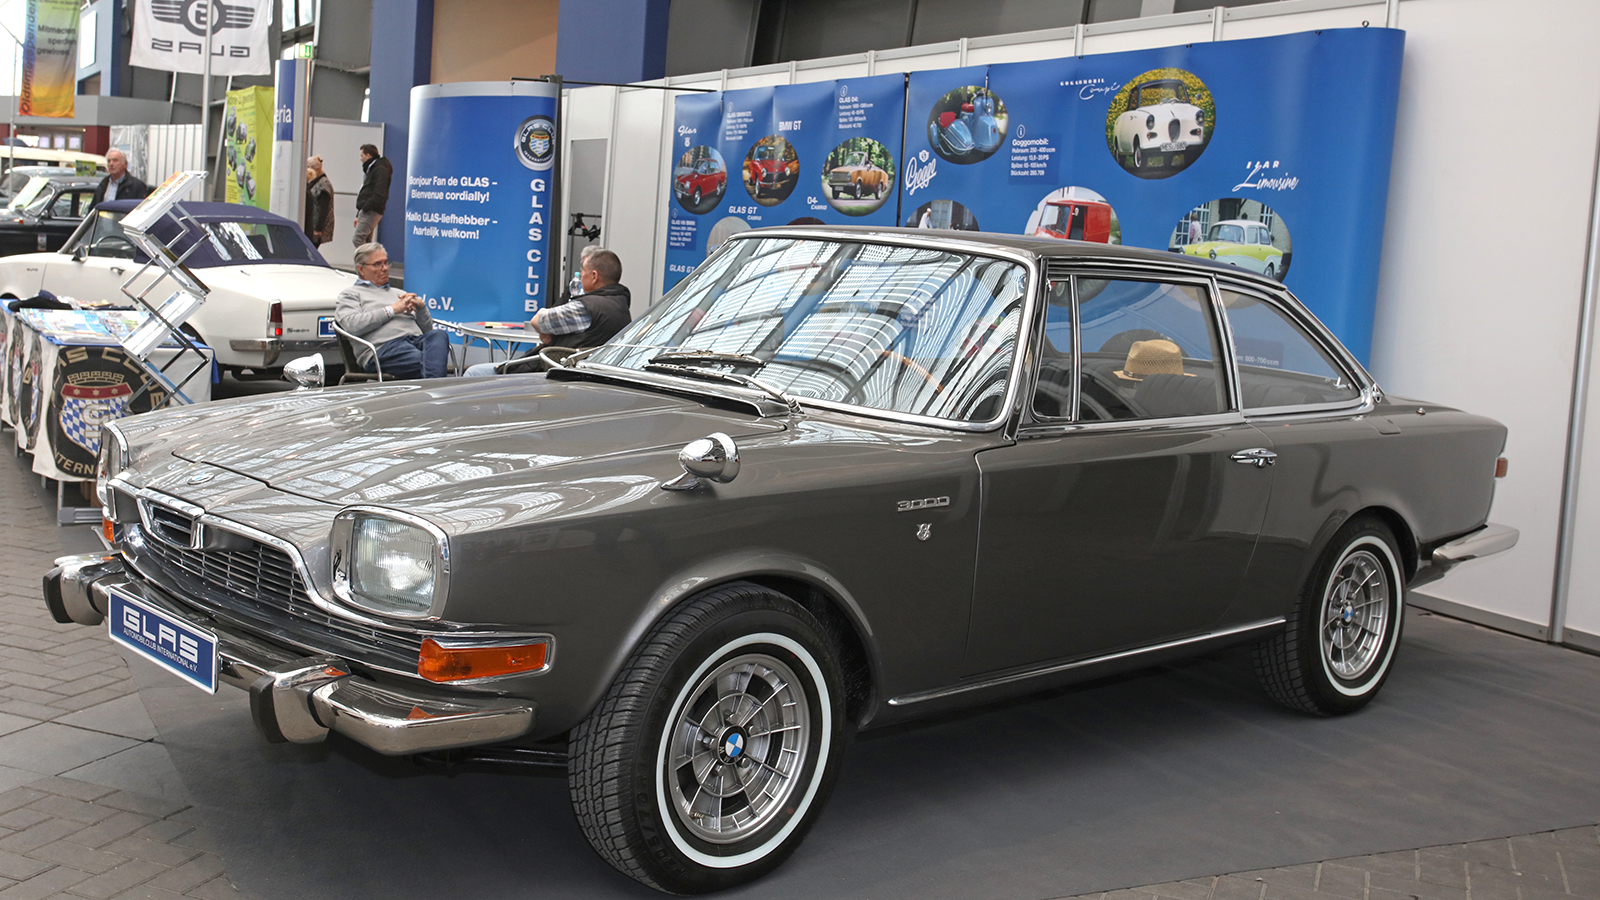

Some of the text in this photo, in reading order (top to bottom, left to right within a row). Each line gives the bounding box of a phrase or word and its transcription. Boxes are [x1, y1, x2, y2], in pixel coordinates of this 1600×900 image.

[521, 123, 540, 143] GLAS
[779, 120, 801, 131] BMW GT
[1012, 138, 1049, 147] Goggomobil:
[409, 176, 432, 187] Bonjour
[433, 176, 446, 186] Fan
[447, 176, 458, 186] de
[460, 176, 490, 187] GLAS
[1231, 164, 1300, 192] Limousine
[411, 189, 490, 204] Bienvenue cordially!
[728, 205, 758, 215] GLAS GT
[406, 212, 421, 222] Hallo
[422, 212, 490, 226] GLAS-liefhebber
[413, 225, 480, 240] hartelijk welkom!
[524, 178, 546, 312] GLAS CLUB
[669, 264, 686, 273] GLAS
[428, 296, 455, 311] e.V.
[897, 496, 950, 512] 3000
[123, 605, 198, 664] GLAS
[123, 627, 156, 651] AUTOMOBILCLUB
[156, 644, 189, 668] INTERNATIONAL
